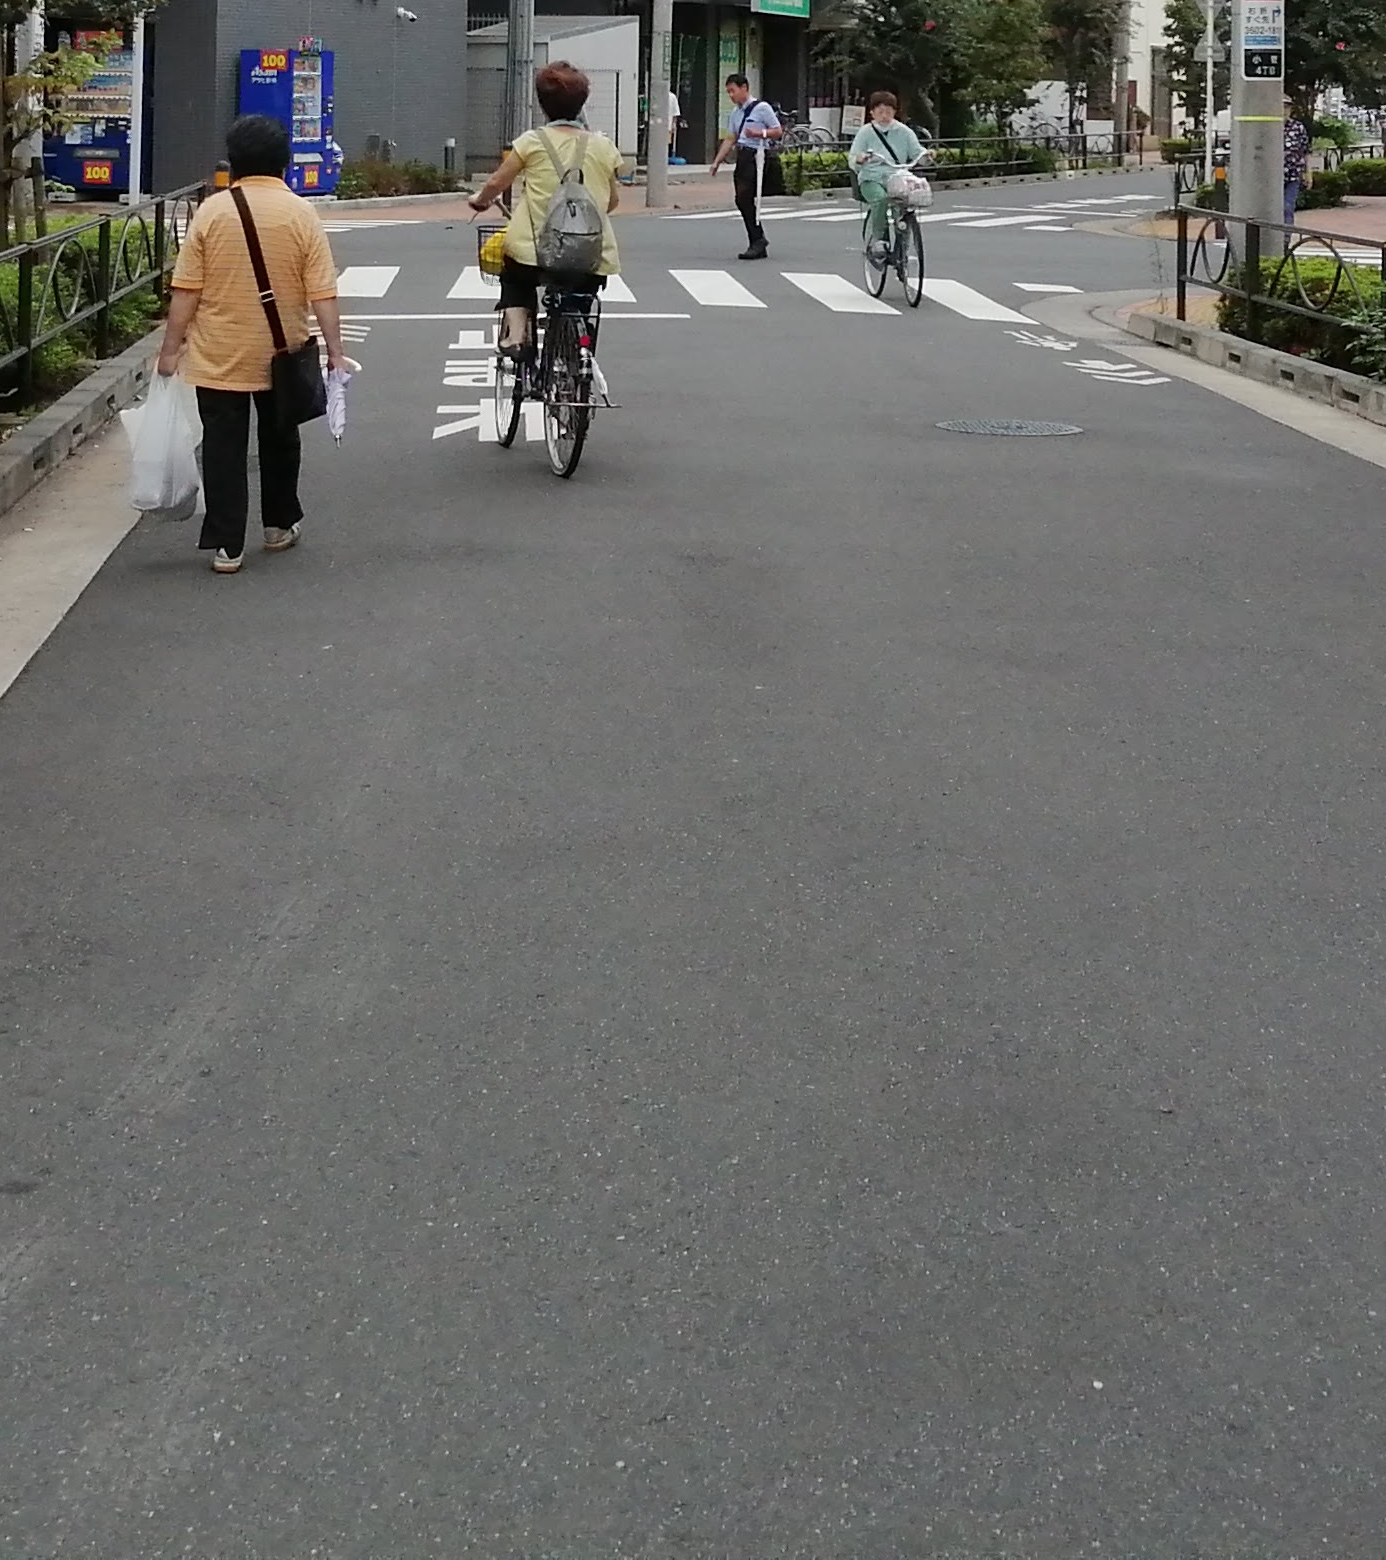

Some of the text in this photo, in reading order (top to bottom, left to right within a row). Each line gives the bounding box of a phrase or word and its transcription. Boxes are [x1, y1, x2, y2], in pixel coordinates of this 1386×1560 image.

[262, 54, 286, 67] 100
[85, 166, 111, 180] 100
[305, 170, 319, 184] 100
